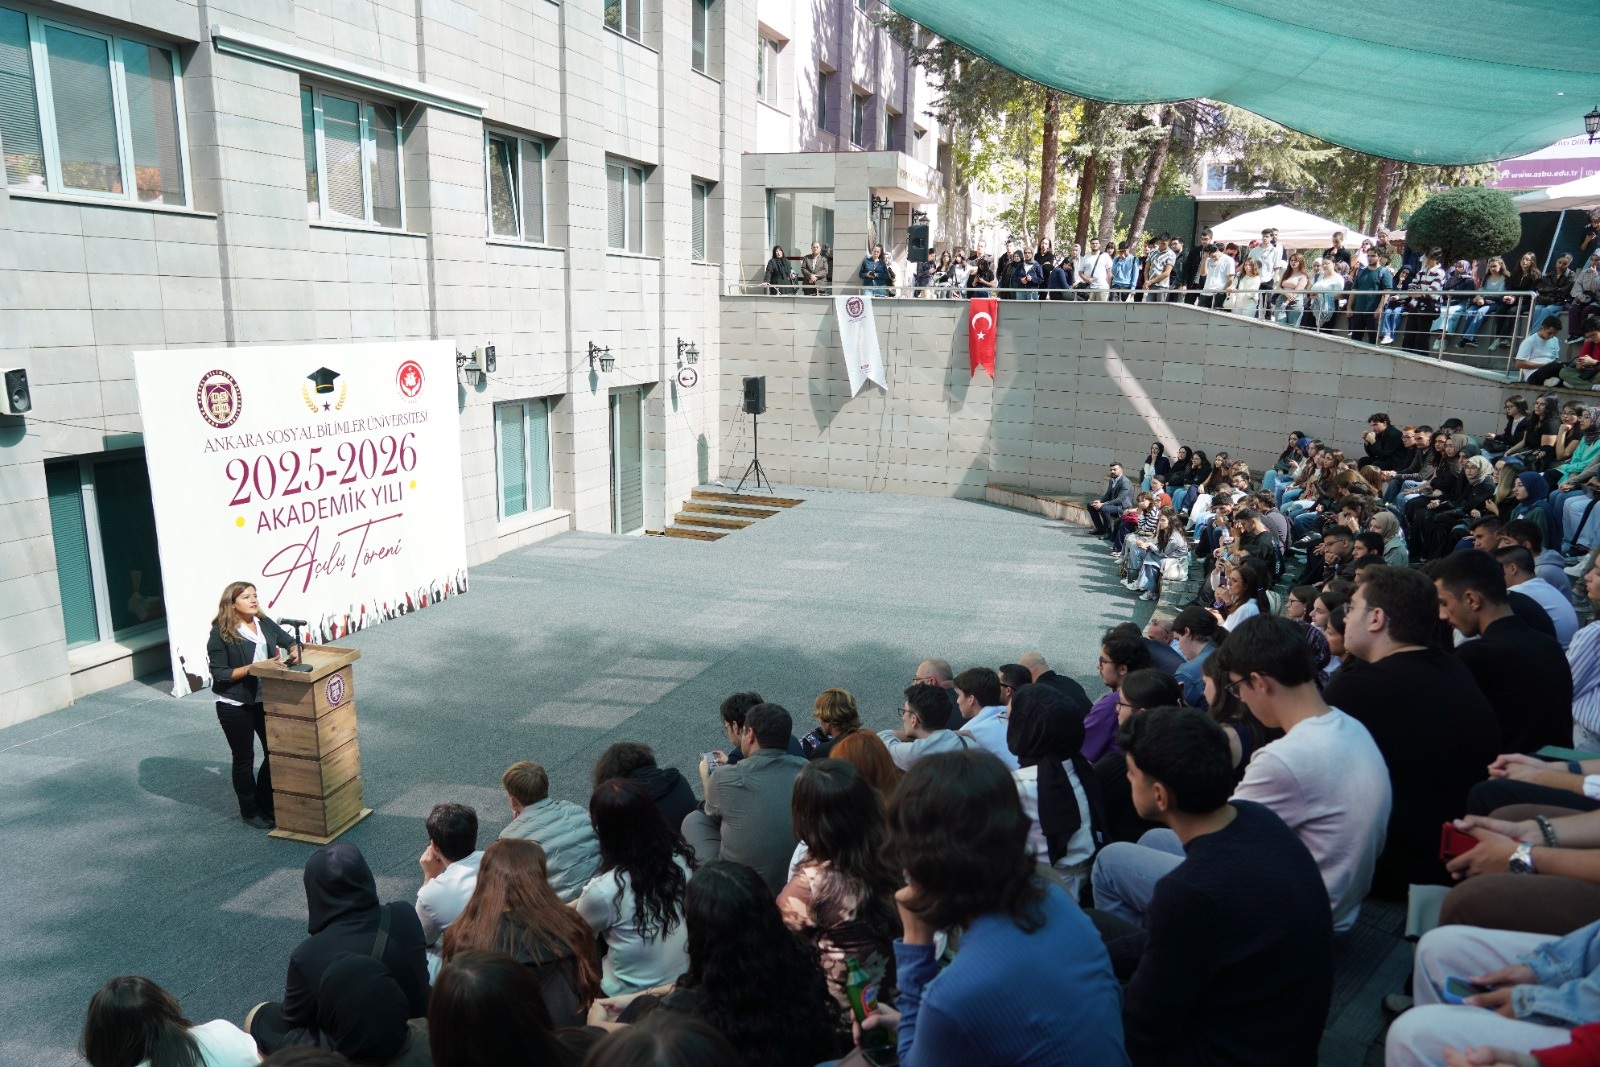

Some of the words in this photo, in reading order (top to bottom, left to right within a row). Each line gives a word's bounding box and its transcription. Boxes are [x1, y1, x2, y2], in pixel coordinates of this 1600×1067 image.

[1511, 169, 1578, 179] www.asbu.edu.tr
[204, 432, 265, 453] ANKARA
[266, 425, 315, 445] SOSYAL
[317, 418, 366, 438] BİLİMLER
[367, 409, 428, 430] ÜNİVERSİTESİ
[225, 432, 417, 507] 2025-2026
[257, 487, 367, 534] AKADEMİK
[371, 482, 403, 506] YILI
[262, 525, 346, 608] Açılış
[337, 513, 404, 578] Töreni
